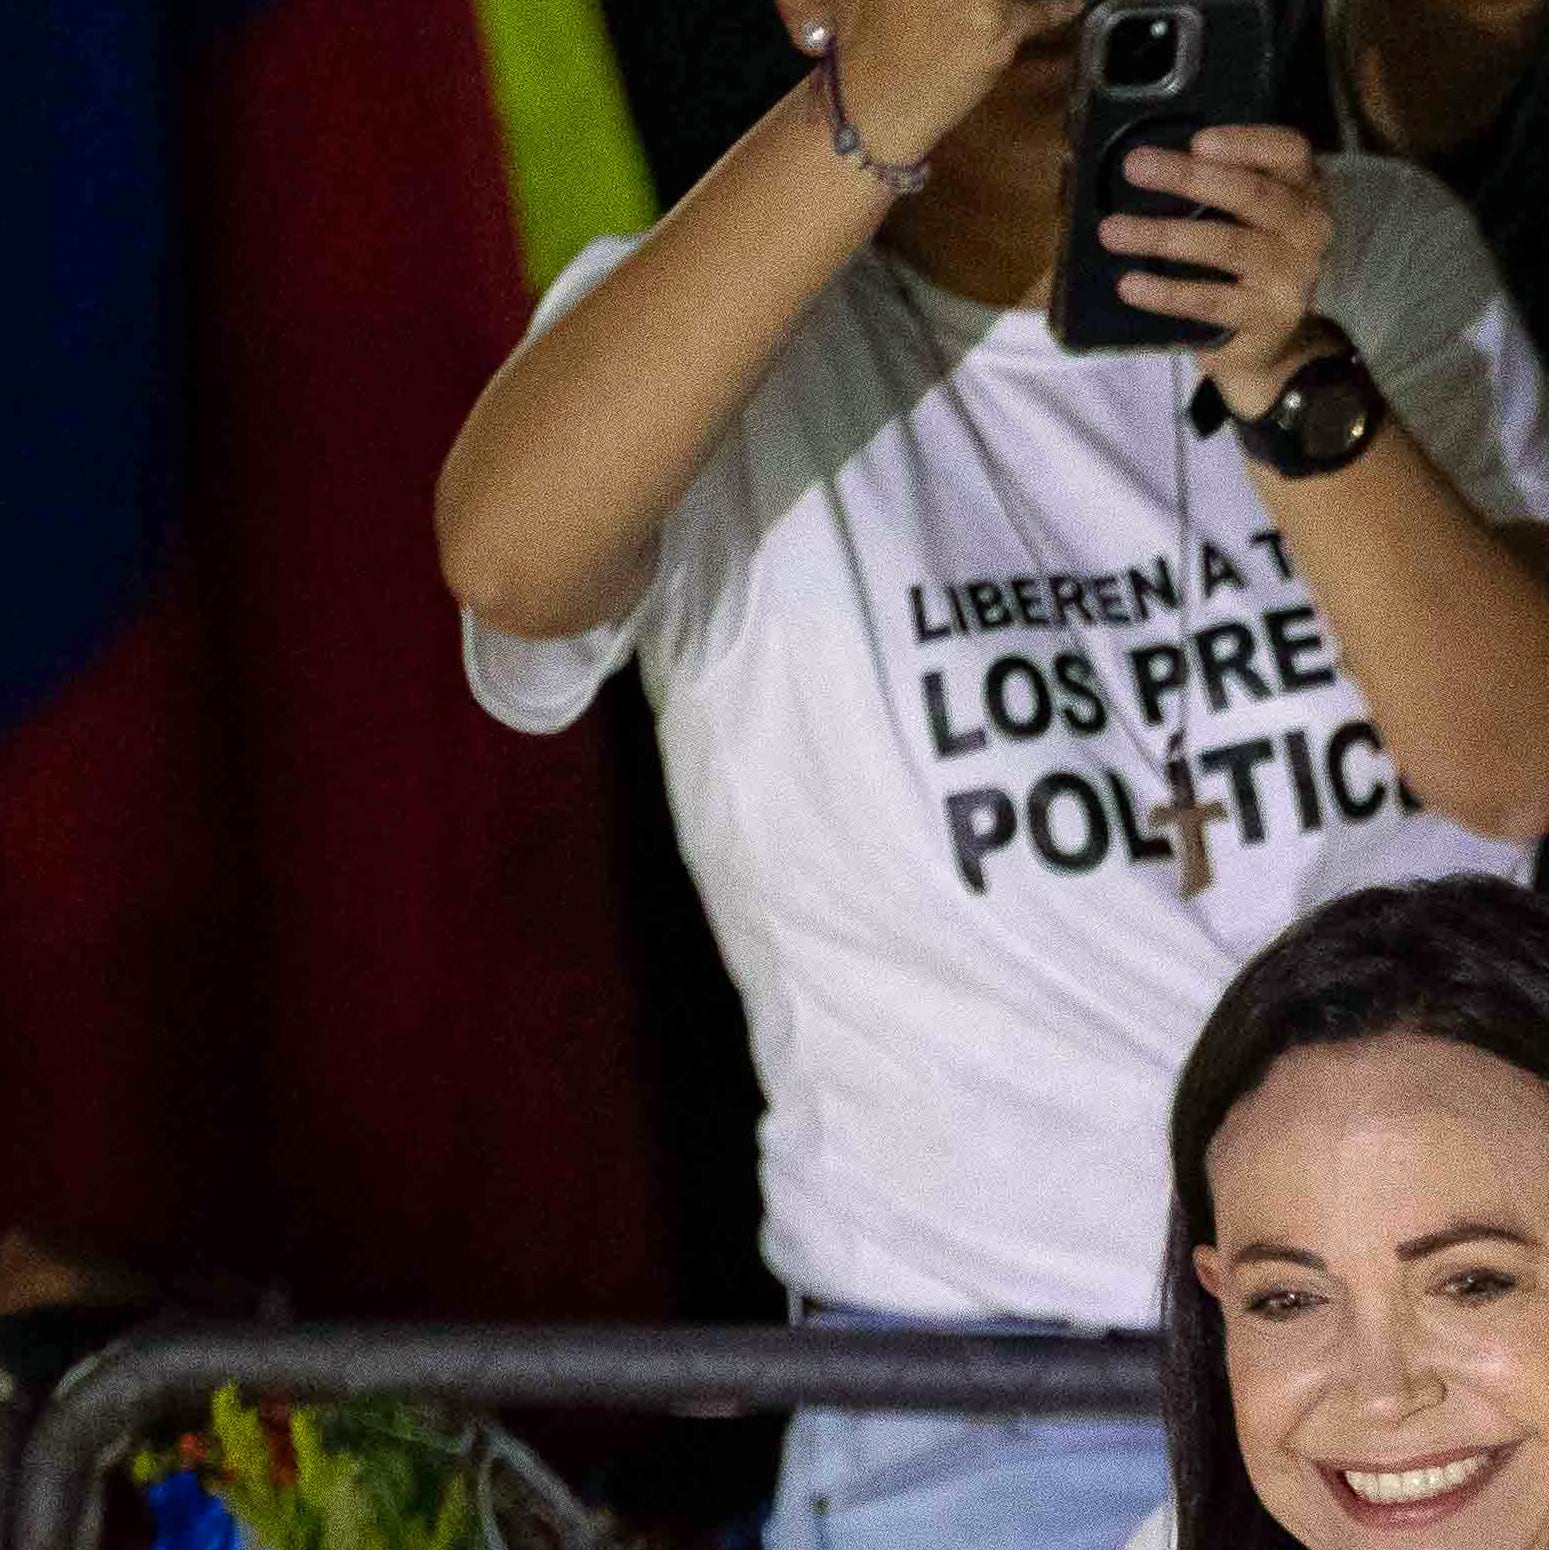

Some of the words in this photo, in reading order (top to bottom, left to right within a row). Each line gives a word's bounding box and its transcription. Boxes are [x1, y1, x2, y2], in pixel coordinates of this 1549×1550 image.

[908, 555, 1184, 643] LIBEREN
[1199, 539, 1246, 599] A
[920, 652, 1108, 760] LOS
[1129, 604, 1338, 726] PRE
[943, 721, 1425, 895] POLÍTIC
